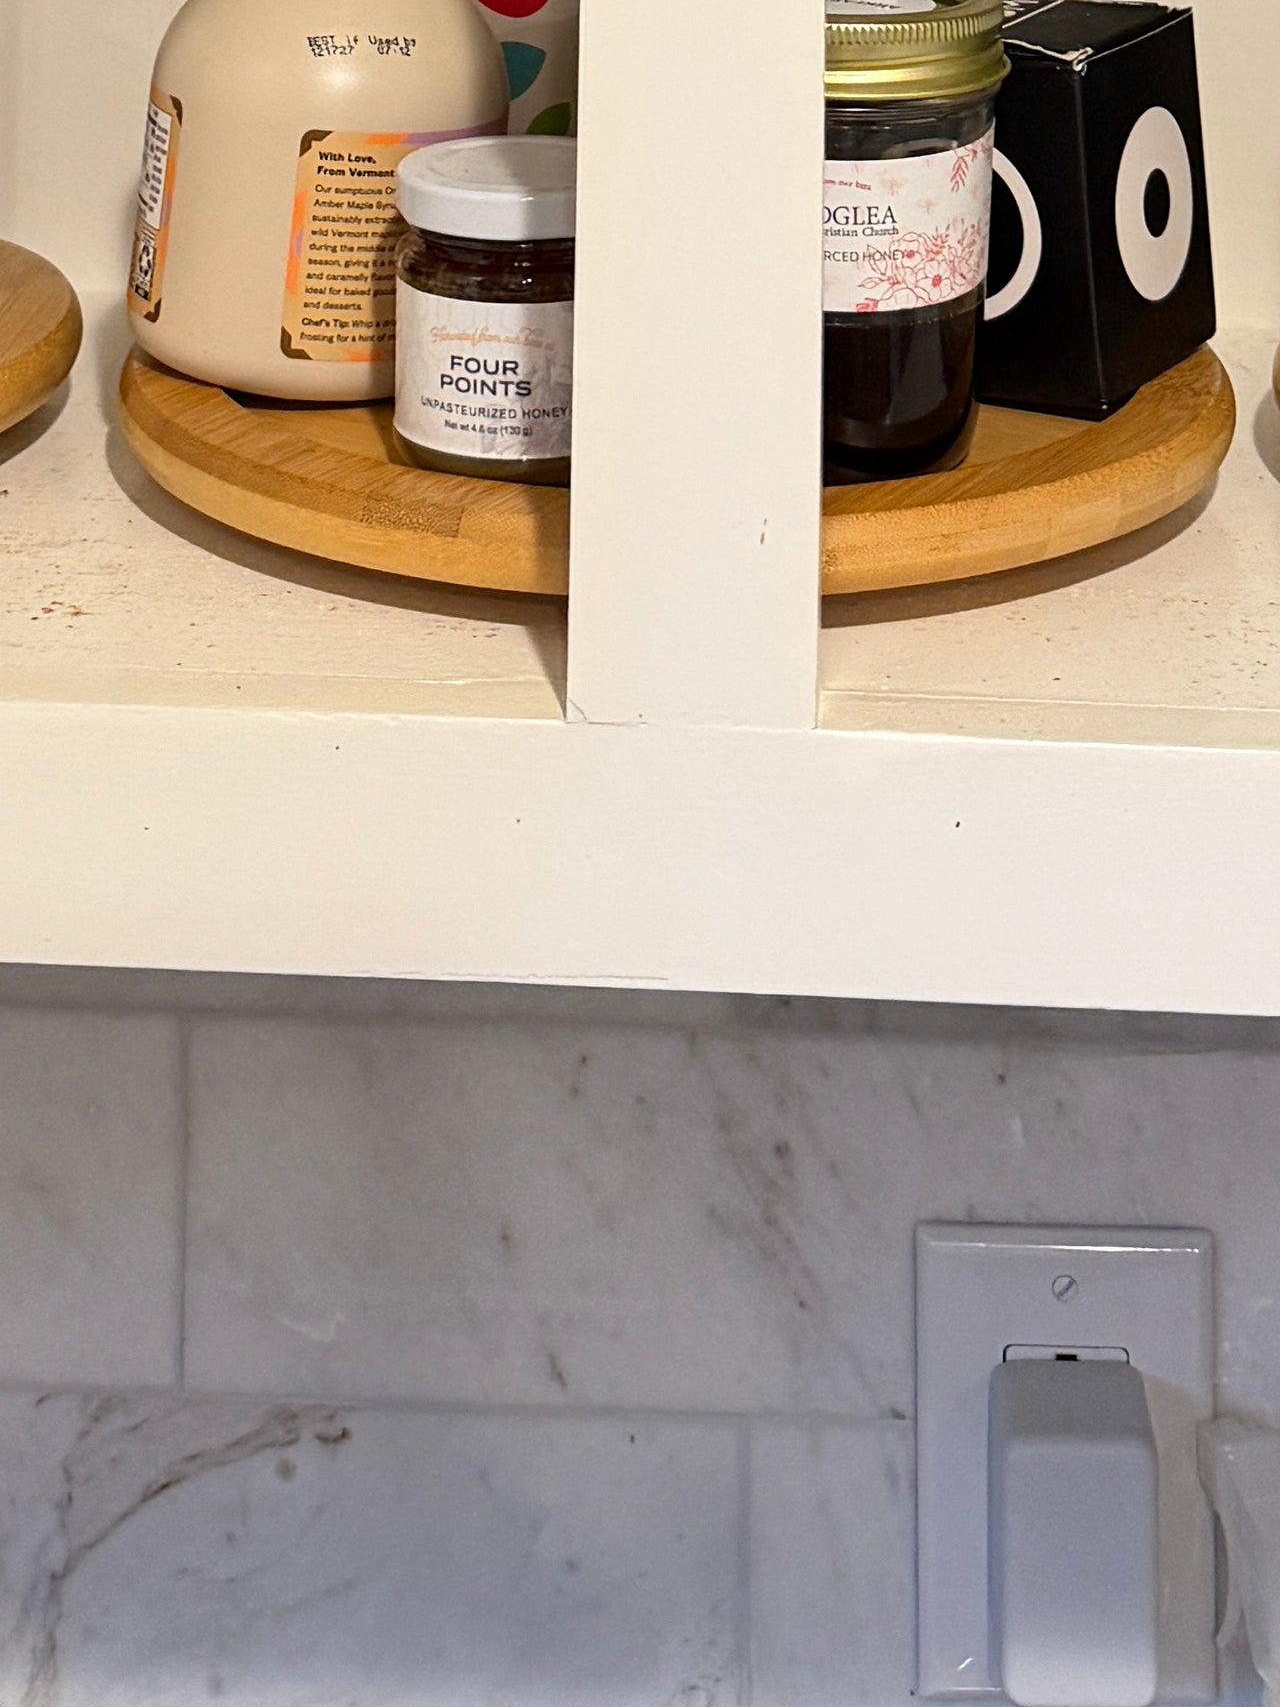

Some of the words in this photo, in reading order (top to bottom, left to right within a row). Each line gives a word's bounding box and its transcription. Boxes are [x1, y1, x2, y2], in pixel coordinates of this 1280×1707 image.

[307, 35, 334, 47] BEST
[368, 35, 399, 45] Used
[319, 152, 344, 161] With
[348, 153, 376, 164] Love,
[318, 166, 345, 176] From
[315, 184, 331, 193] Our
[314, 199, 344, 208] Amber
[347, 201, 373, 210] Maple
[332, 229, 368, 238] Vermont
[862, 225, 899, 236] Church
[451, 355, 519, 375] FOUR
[440, 374, 532, 396] POINTS
[421, 396, 517, 419] UNPASTEURIZED
[522, 406, 568, 419] HONEY
